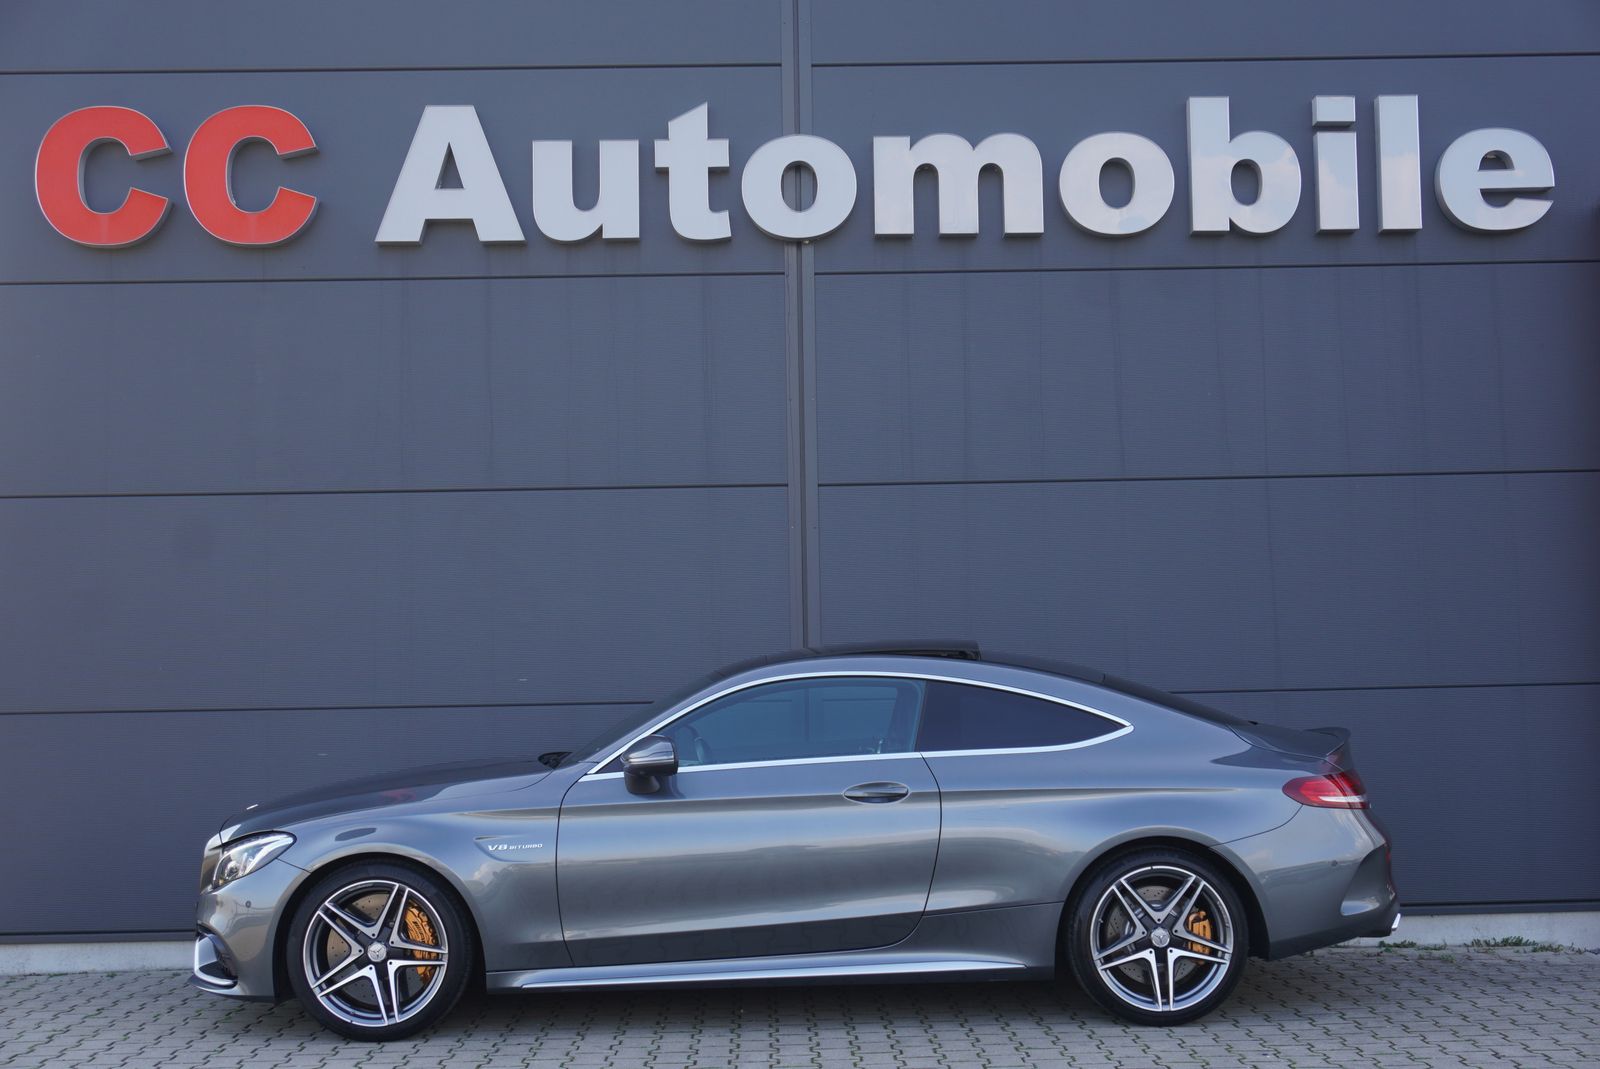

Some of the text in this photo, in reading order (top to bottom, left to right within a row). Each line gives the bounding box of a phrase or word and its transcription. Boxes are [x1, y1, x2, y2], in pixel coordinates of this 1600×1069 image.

[35, 94, 1556, 248] CC Automobile
[487, 843, 508, 851] V8
